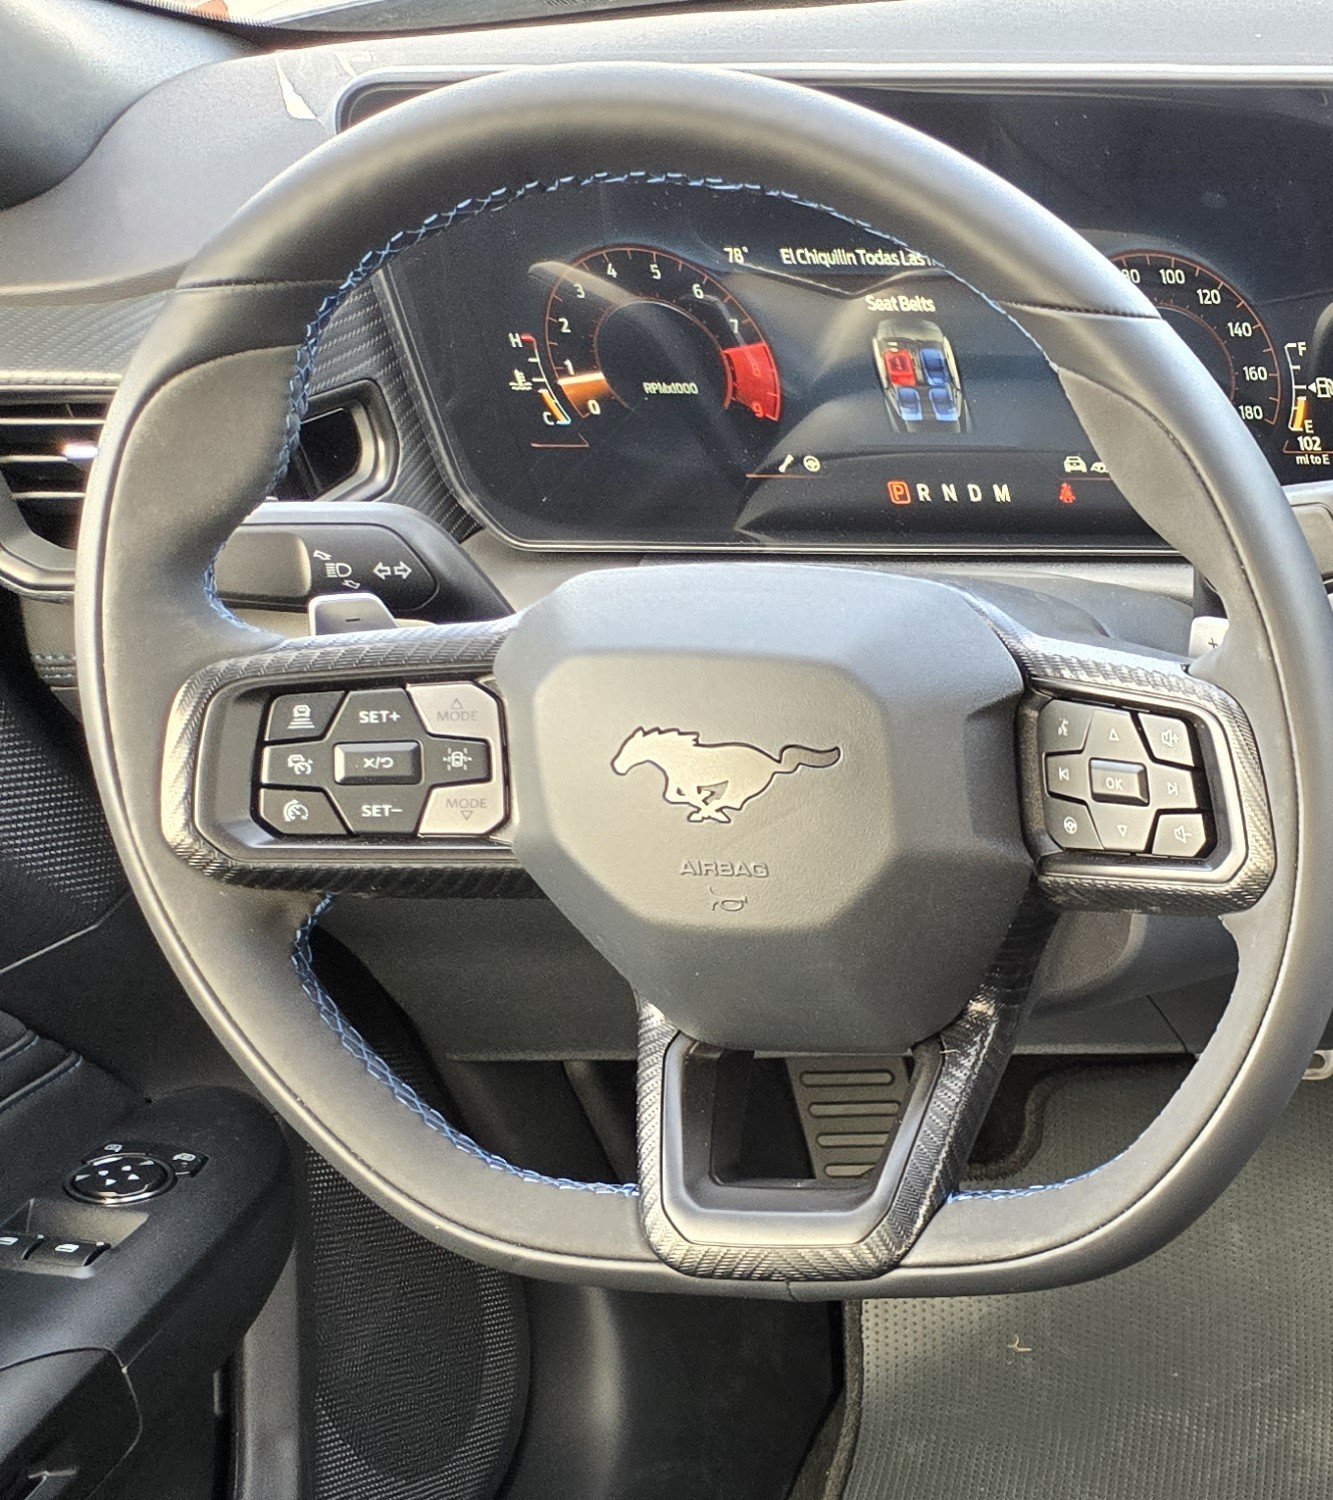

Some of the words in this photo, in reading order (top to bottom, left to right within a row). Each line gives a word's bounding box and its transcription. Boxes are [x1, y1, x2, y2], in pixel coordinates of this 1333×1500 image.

[724, 246, 749, 264] 78°
[858, 250, 899, 267] Todas
[606, 263, 618, 278] 4
[650, 264, 662, 280] 5
[1159, 269, 1186, 284] 100
[575, 283, 585, 299] 3
[692, 283, 704, 299] 6
[1196, 289, 1222, 305] 120
[865, 294, 899, 312] Seat
[902, 295, 936, 313] Belts
[559, 318, 571, 333] 2
[729, 318, 739, 334] 7
[1227, 321, 1252, 338] 140
[508, 333, 523, 348] H
[1297, 341, 1307, 356] F
[564, 359, 574, 375] 1
[1243, 366, 1268, 381] 160
[588, 400, 601, 415] 0
[1239, 405, 1263, 420] 180
[543, 412, 555, 425] C
[1303, 419, 1314, 434] E
[1297, 435, 1322, 452] 102
[1311, 455, 1321, 465] to
[1322, 455, 1331, 465] E
[916, 482, 932, 502] R
[941, 483, 958, 502] N
[967, 483, 983, 502] D
[992, 483, 1011, 503] M
[437, 711, 479, 722] MODE
[1105, 776, 1123, 790] OK
[445, 798, 488, 809] MODE
[680, 859, 769, 878] AIRBAG
